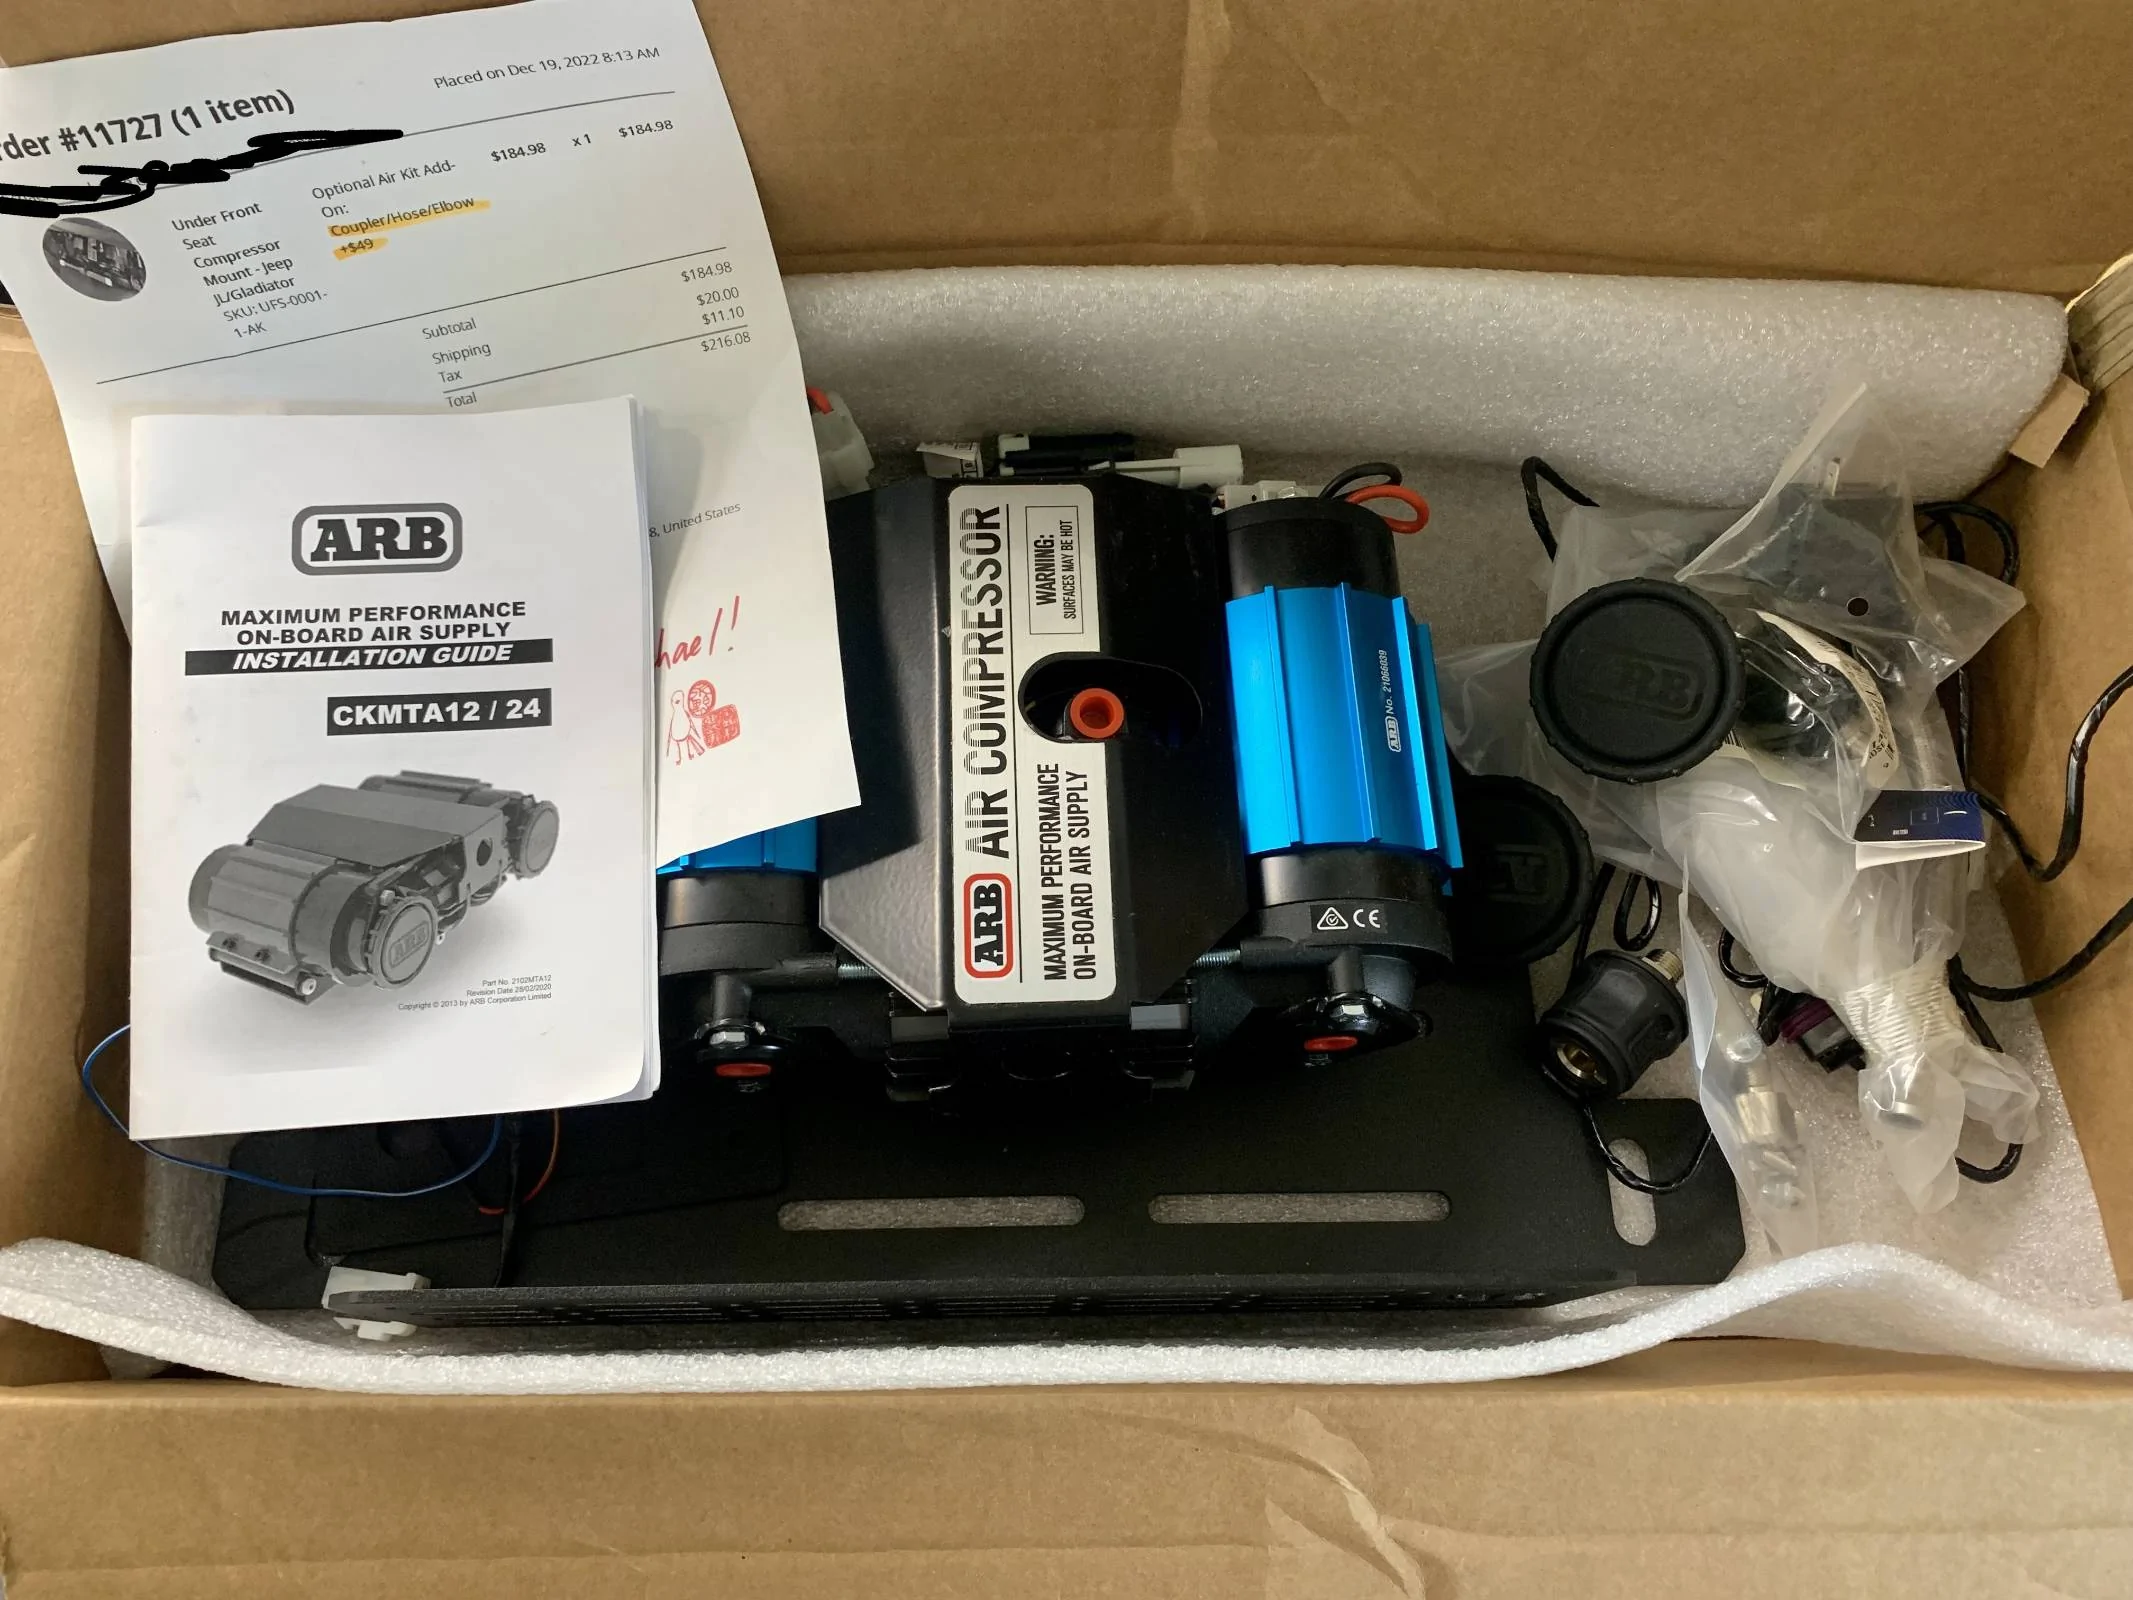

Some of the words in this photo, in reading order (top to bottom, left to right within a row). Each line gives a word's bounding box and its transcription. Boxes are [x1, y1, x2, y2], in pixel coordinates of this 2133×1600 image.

[434, 70, 483, 89] Placed
[486, 67, 506, 81] on
[508, 60, 537, 77] Dec
[540, 58, 562, 73] 19,
[566, 52, 600, 69] 2022
[602, 49, 633, 64] 8:13
[636, 47, 660, 60] AM
[0, 132, 51, 161] der
[58, 114, 163, 153] #11727
[170, 109, 202, 136] (1
[203, 88, 295, 128] item)
[491, 142, 546, 162] $184.98
[584, 133, 592, 145] 1
[618, 119, 674, 139] $184.98
[312, 177, 379, 199] Optional
[376, 171, 398, 188] Air
[401, 166, 421, 181] Kit
[423, 161, 457, 178] Add-
[171, 216, 219, 234] Under
[221, 203, 263, 222] Front
[321, 204, 350, 219] On:
[330, 197, 475, 240] Coupler/Hose/Elbow
[183, 234, 217, 251] Seat
[194, 239, 282, 270] Compressor
[340, 238, 375, 255] +$49
[203, 266, 250, 287] Mount
[263, 256, 294, 279] Jeep
[681, 261, 733, 284] $184.98
[214, 275, 296, 305] JL/Gladiator
[696, 286, 740, 307] $20.00
[223, 305, 258, 322] SKU:
[258, 291, 329, 314] UFS-0001-
[702, 306, 745, 327] $11.10
[234, 322, 267, 339] 1-AK
[422, 317, 477, 340] Subtotal
[700, 331, 752, 353] $216.08
[432, 342, 492, 366] Shipping
[439, 369, 463, 384] Tax
[446, 392, 477, 409] Total
[662, 513, 702, 534] United
[704, 503, 741, 521] States
[1060, 519, 1073, 537] HOT
[310, 516, 448, 562] ARB
[1061, 538, 1074, 552] BE
[1033, 534, 1057, 606] WARNING:
[1061, 554, 1075, 572] MAY
[1061, 574, 1077, 620] SURFACES
[221, 608, 341, 626] MAXIMUM
[349, 601, 526, 622] PERFORMANCE
[236, 626, 363, 646] ON-BOARD
[371, 625, 412, 641] AIR
[420, 622, 511, 639] SUPPLY
[959, 506, 1007, 775] COMPRESSOR
[232, 647, 425, 670] INSTALLATION
[432, 644, 514, 664] GUIDE
[333, 702, 481, 726] CKMTA12
[506, 698, 542, 719] 24
[1387, 719, 1399, 749] ARB
[1066, 770, 1090, 839] SUPPLY
[964, 788, 1009, 859] AIR
[1036, 763, 1063, 888] PERFORMANCE
[1069, 845, 1092, 876] AIR
[973, 883, 1004, 967] ARB
[1042, 894, 1067, 981] MAXIMUM
[1070, 882, 1096, 980] ON-BOARD
[467, 988, 496, 997] Revision
[497, 986, 513, 994] Date
[482, 979, 497, 987] Part
[399, 1001, 431, 1010] Copyright
[441, 999, 458, 1007] 2013
[460, 999, 468, 1007] by
[488, 994, 527, 1004] Corporation
[528, 992, 552, 1000] Limited
